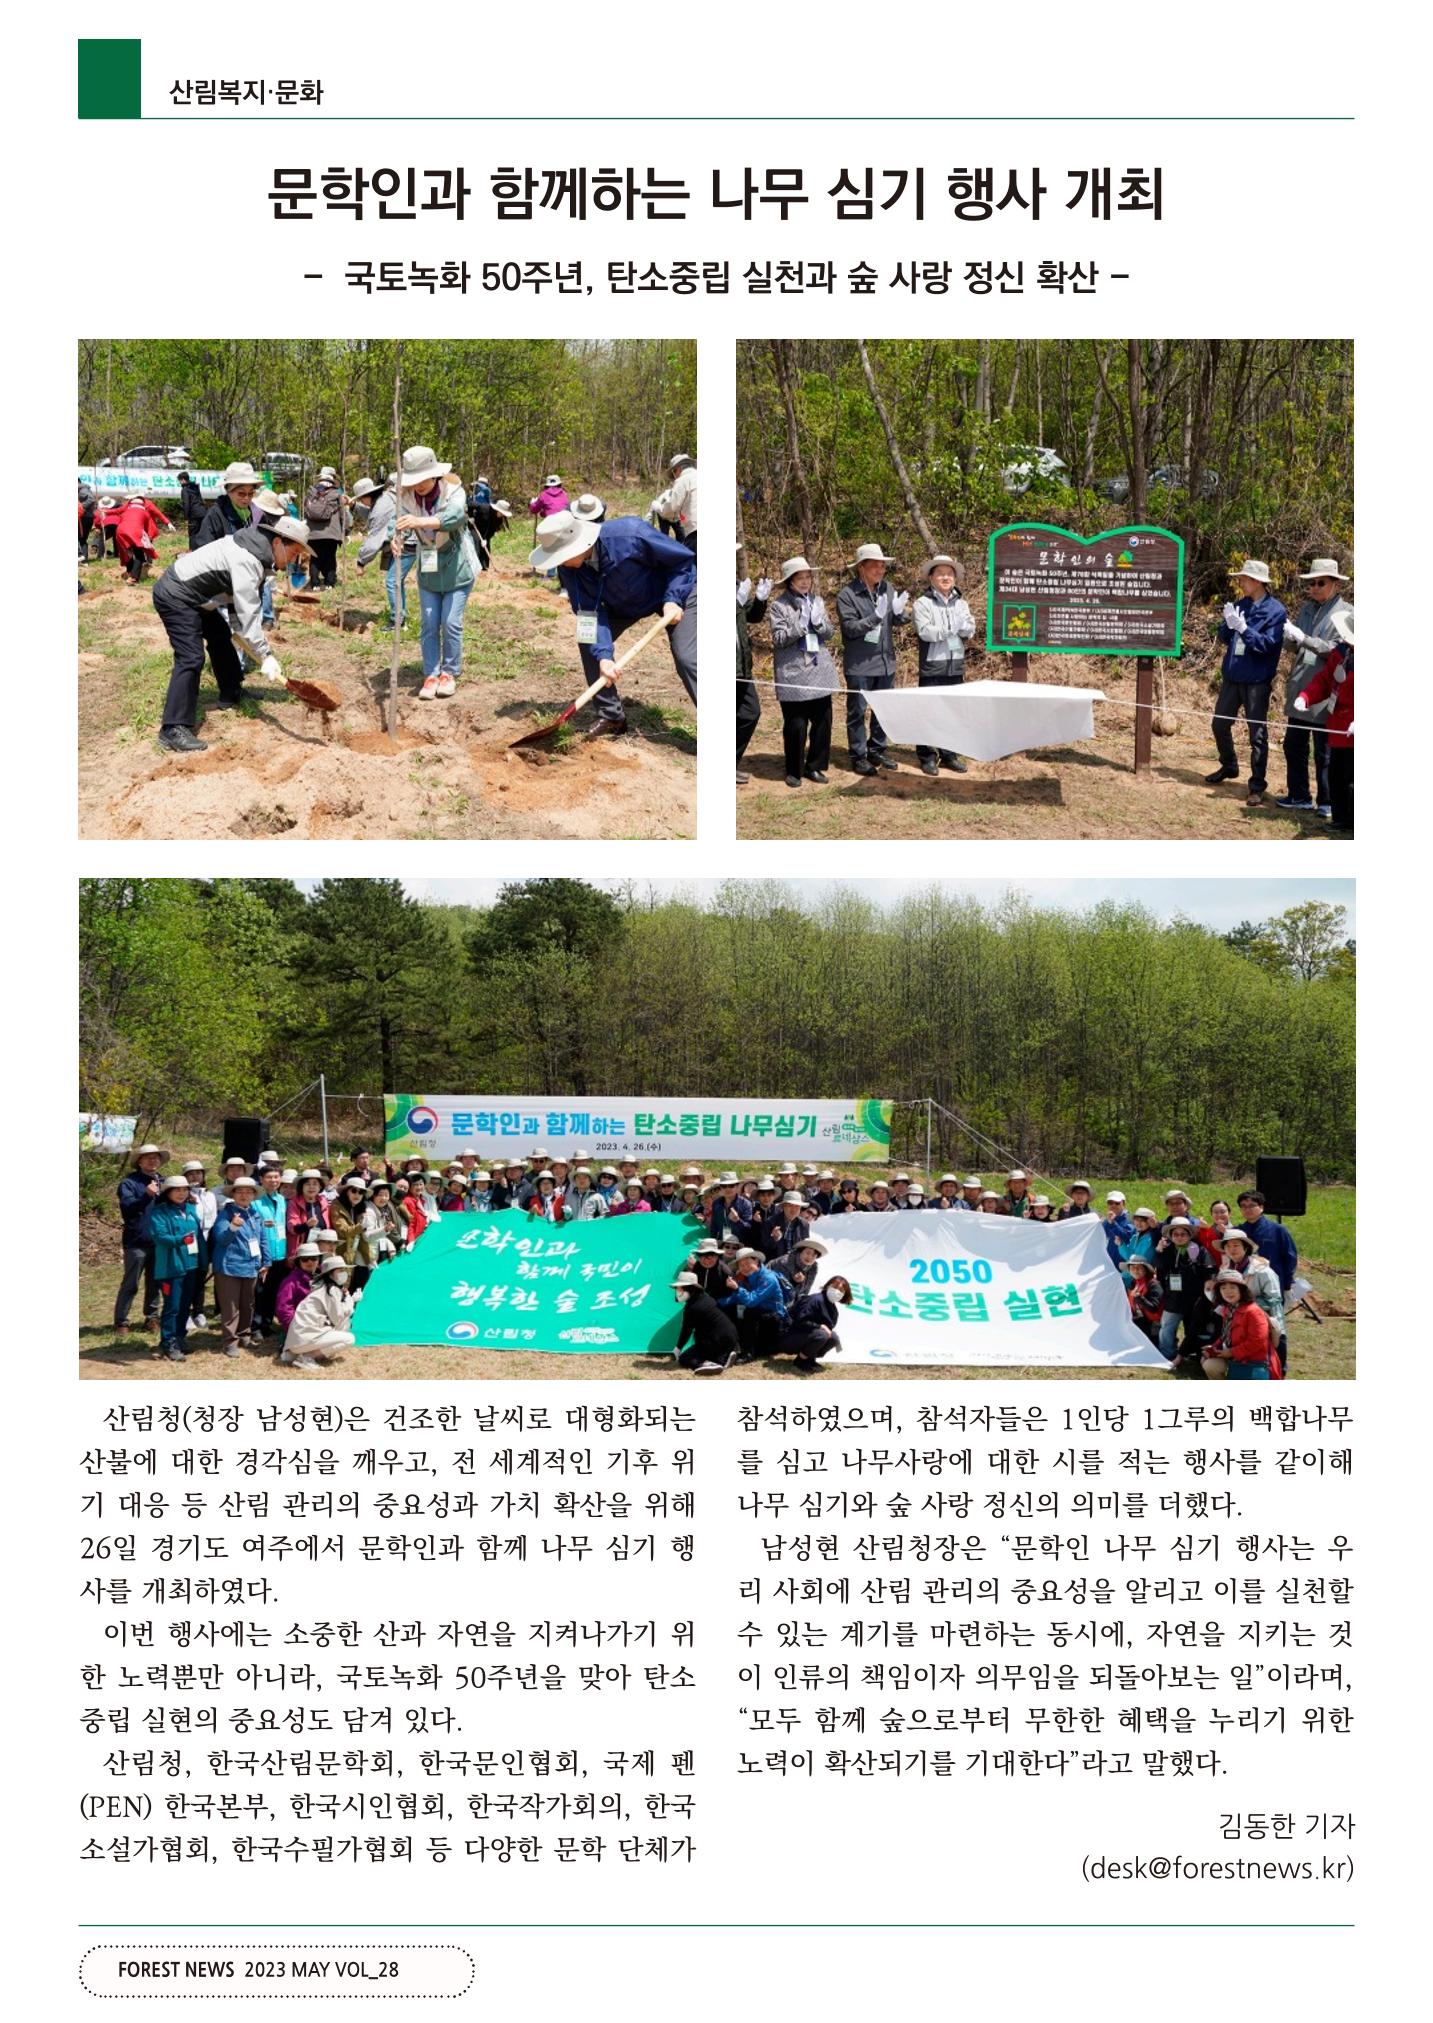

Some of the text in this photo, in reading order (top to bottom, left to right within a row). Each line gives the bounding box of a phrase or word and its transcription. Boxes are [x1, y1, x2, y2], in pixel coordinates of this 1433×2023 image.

[168, 79, 325, 106] 산림복지·문화
[267, 166, 1162, 222] 문학인과 함께하는 나무 심기 행사 개최
[344, 260, 1100, 296] 국토녹화 50주년, 탄소중립 실천과 숲 사랑 정신 확산
[1039, 550, 1096, 567] 문학인의
[451, 1112, 818, 1138] 문학인과 함께하는 탄소중립 나무심기
[595, 1142, 620, 1151] 2023.
[622, 1142, 632, 1151] 4.
[516, 1258, 643, 1282] 함께 국민이
[908, 1257, 993, 1284] 2050
[450, 1280, 540, 1311] 행복한
[589, 1283, 652, 1310] 조성
[845, 1283, 1084, 1323] 탄소중립 실현
[484, 1327, 536, 1340] 산림청
[103, 1405, 696, 1433] 산림청(청장 남성현)은 건조한 날씨로 대형화되는
[737, 1405, 1354, 1434] 참석하였으며, 참석자들은 1인당 1그루의 백합나무
[79, 1448, 694, 1477] 산불에 대한 경각심을 깨우고, 전 세계적인 기후 위
[737, 1491, 1242, 1519] 나무 심기와 숲 사랑 정신의 의미를 더했다.
[761, 1534, 1354, 1562] 남성현 산림청장은 “문학인 나무 심기 행사는 우
[79, 1577, 278, 1605] 사를 개최하였다.
[104, 1620, 694, 1648] 이번 행사에는 소중한 산과 자연을 지켜나가기 위
[80, 1663, 696, 1693] 한 노력뿐만 아니라, 국토녹화 50주년을 맞아 탄소
[738, 1663, 1352, 1693] 이 인류의 책임이자 의무임을 되돌아보는 일”이라며,
[739, 1706, 1355, 1734] “모두 함께 숲으로부터 무한한 혜택을 누리기 위한
[103, 1749, 696, 1779] 산림청, 한국산림문학회, 한국문인협회, 국제 펜
[737, 1749, 1227, 1778] 노력이 확산되기를 기대한다”라고 말했다.
[1219, 1812, 1356, 1840] 김동한 기자
[79, 1835, 697, 1865] 소설가협회, 한국수필가협회 등 다양한 문학 단체가
[1082, 1854, 1354, 1883] (desk@forestnews.kr)
[118, 1960, 399, 1980] FOREST NEWS 2023 MAY VOL_28
